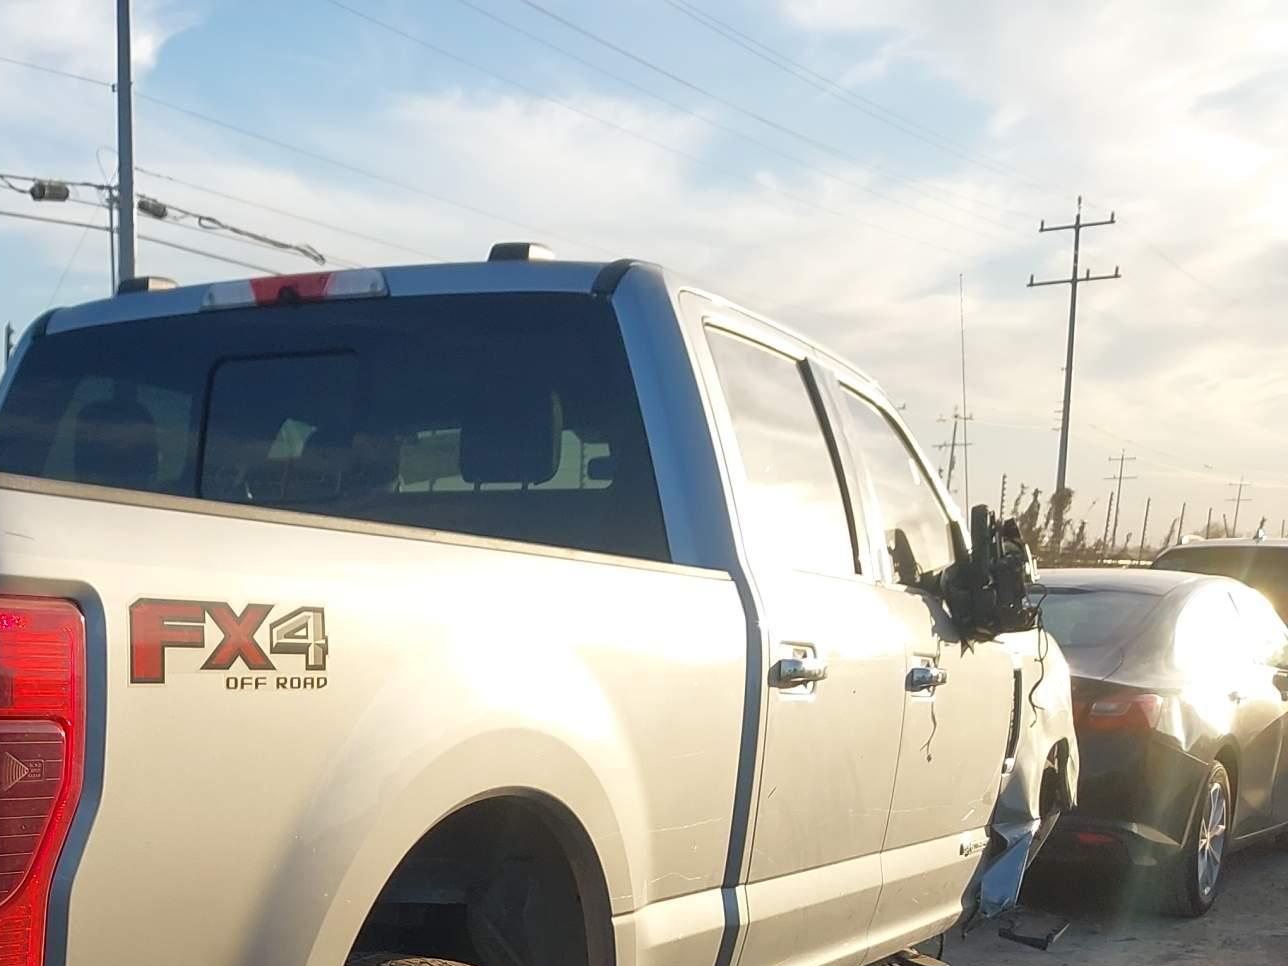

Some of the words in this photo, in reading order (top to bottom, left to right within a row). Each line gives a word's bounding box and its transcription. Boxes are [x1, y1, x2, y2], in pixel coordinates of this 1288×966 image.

[129, 597, 329, 685] FX4
[225, 676, 268, 690] OFF
[275, 676, 328, 690] ROAD
